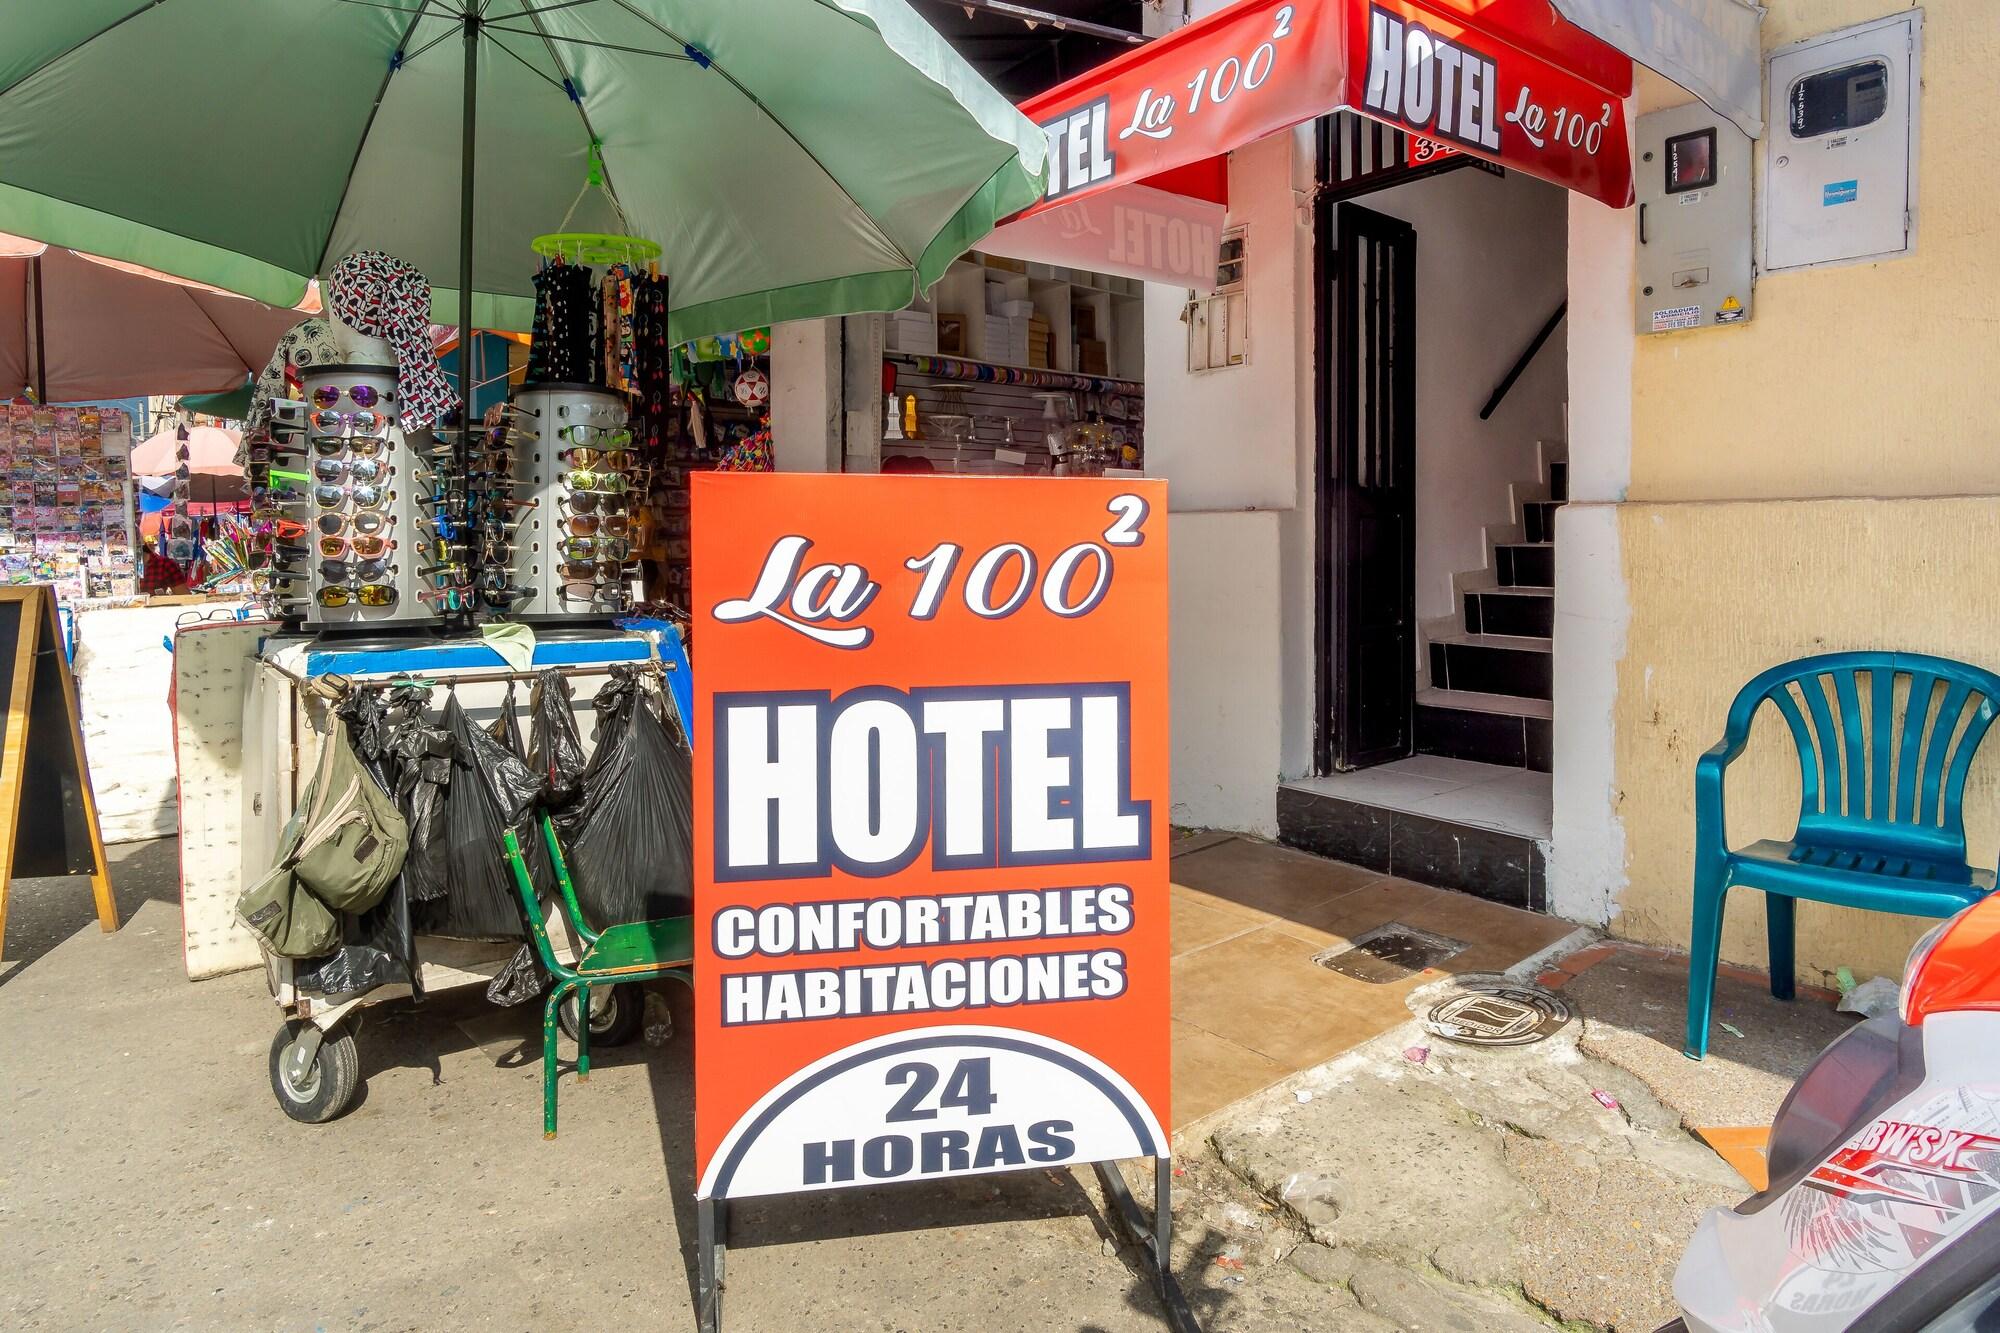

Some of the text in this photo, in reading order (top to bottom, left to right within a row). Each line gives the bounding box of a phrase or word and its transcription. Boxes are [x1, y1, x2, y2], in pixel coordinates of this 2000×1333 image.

[1366, 10, 1499, 150] HOTEL
[1505, 86, 1546, 148] La
[1045, 101, 1112, 197] TEL
[1119, 89, 1176, 139] La
[1654, 306, 1699, 316] SOLDADURA
[712, 535, 881, 649] La
[720, 690, 1144, 872] HOTEL
[715, 886, 1133, 957] CONFORTABLES
[723, 949, 1126, 1026] HABITACIONES
[1451, 1017, 1502, 1034] MEDIDOR
[885, 1057, 997, 1123] 24
[803, 1120, 1075, 1185] HORAS
